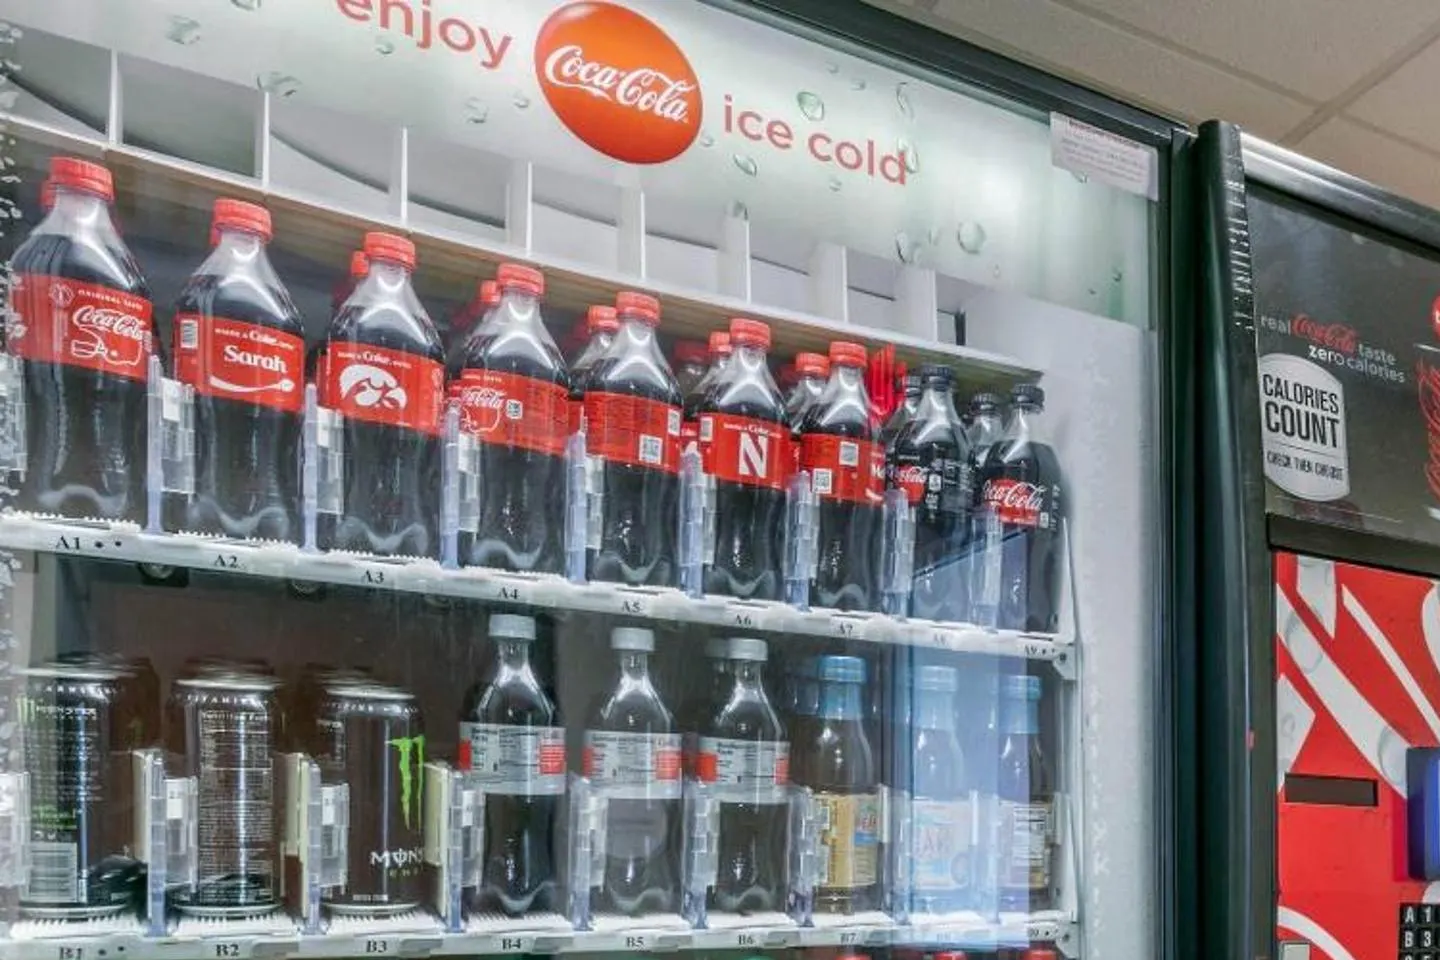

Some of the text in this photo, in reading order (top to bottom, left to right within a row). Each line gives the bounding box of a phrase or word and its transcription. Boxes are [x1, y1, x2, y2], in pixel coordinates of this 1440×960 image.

[337, 0, 513, 69] enjoy
[544, 45, 694, 125] Coca-Cola
[723, 95, 908, 186] ice cold
[1261, 315, 1291, 335] real
[1359, 344, 1396, 366] taste
[223, 344, 289, 375] Sarah
[1309, 344, 1405, 384] zero calories
[1262, 374, 1340, 415] CALORIES
[1265, 401, 1340, 449] COUNT
[739, 432, 768, 478] N
[55, 535, 82, 552] A1
[213, 553, 239, 569] A2
[361, 569, 385, 585] A3
[498, 586, 520, 601] A4
[622, 600, 642, 614] A5
[734, 612, 753, 627] A6
[1405, 907, 1414, 923] A
[1424, 907, 1432, 923] 1
[366, 939, 388, 954] B3
[502, 937, 522, 951] B4
[626, 935, 645, 949] B5
[1405, 931, 1414, 948] B
[1423, 930, 1432, 947] 3
[59, 946, 84, 960] B1
[215, 943, 240, 958] B2
